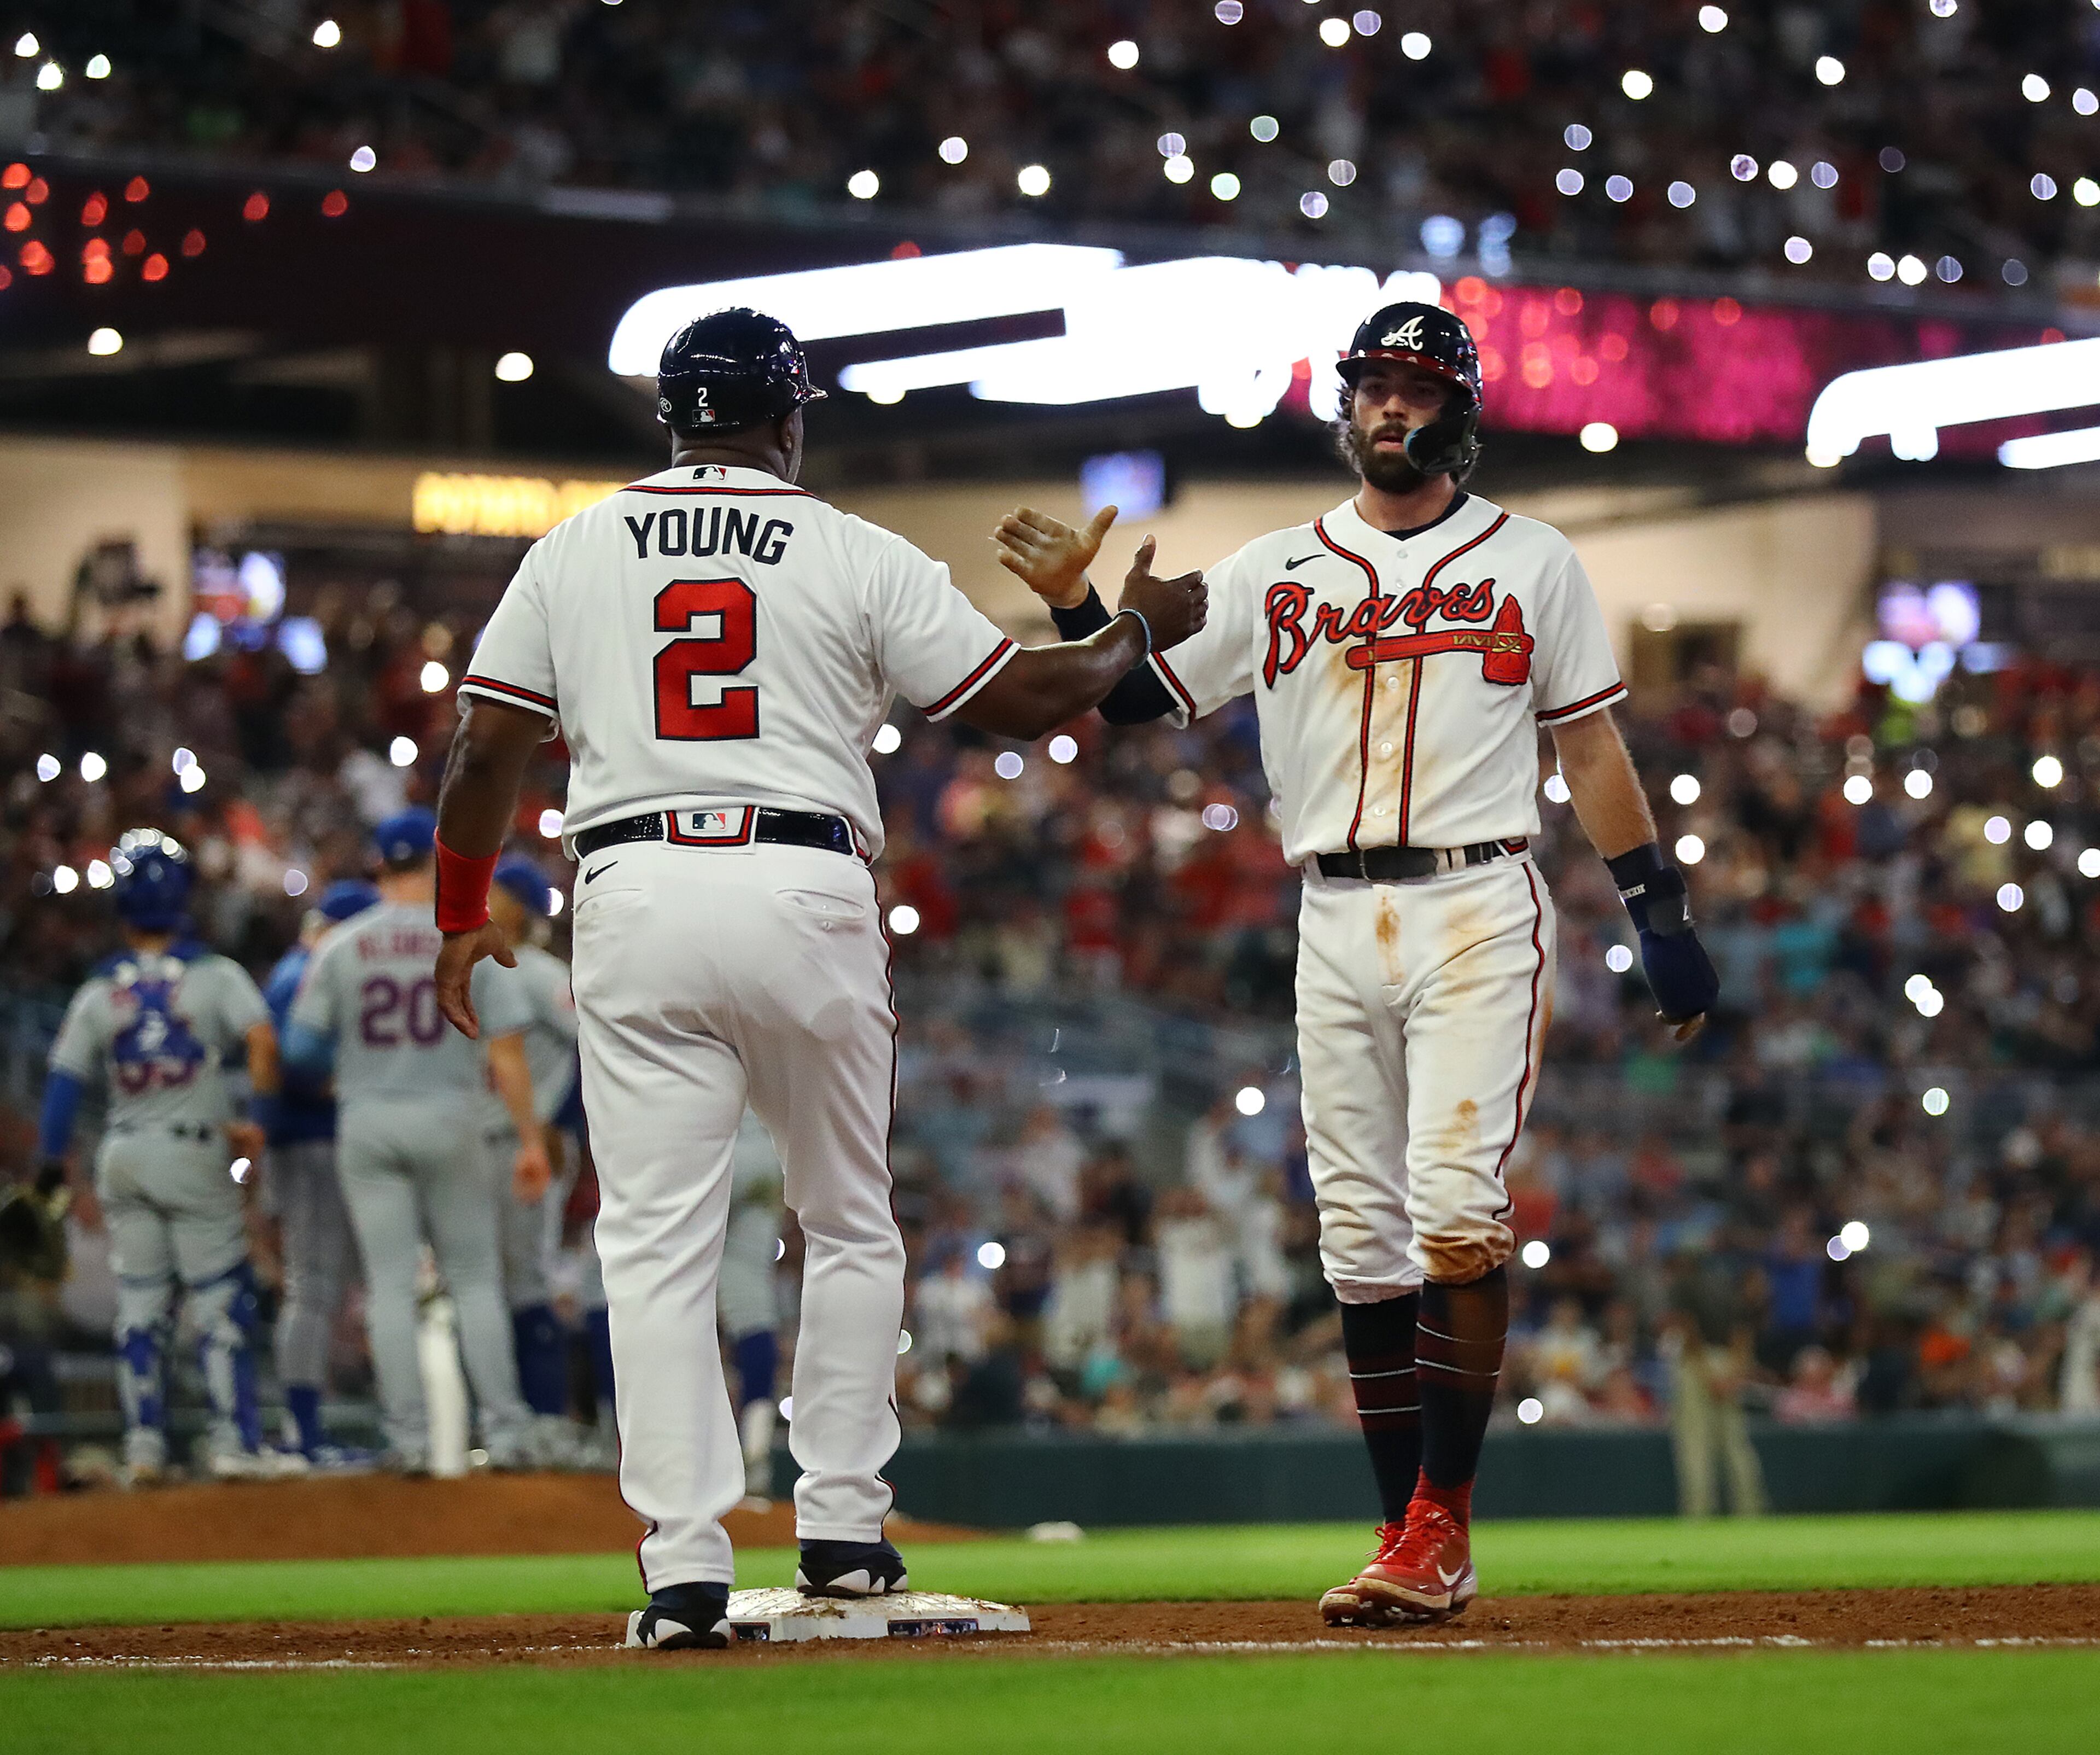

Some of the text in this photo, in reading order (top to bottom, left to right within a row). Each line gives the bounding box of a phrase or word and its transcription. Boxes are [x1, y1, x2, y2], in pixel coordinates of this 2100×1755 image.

[1380, 315, 1425, 351] A
[697, 387, 708, 407] 2
[624, 506, 795, 565] YOUNG
[653, 577, 760, 742] 2
[1262, 578, 1496, 690] Braves
[361, 976, 445, 1047] 20
